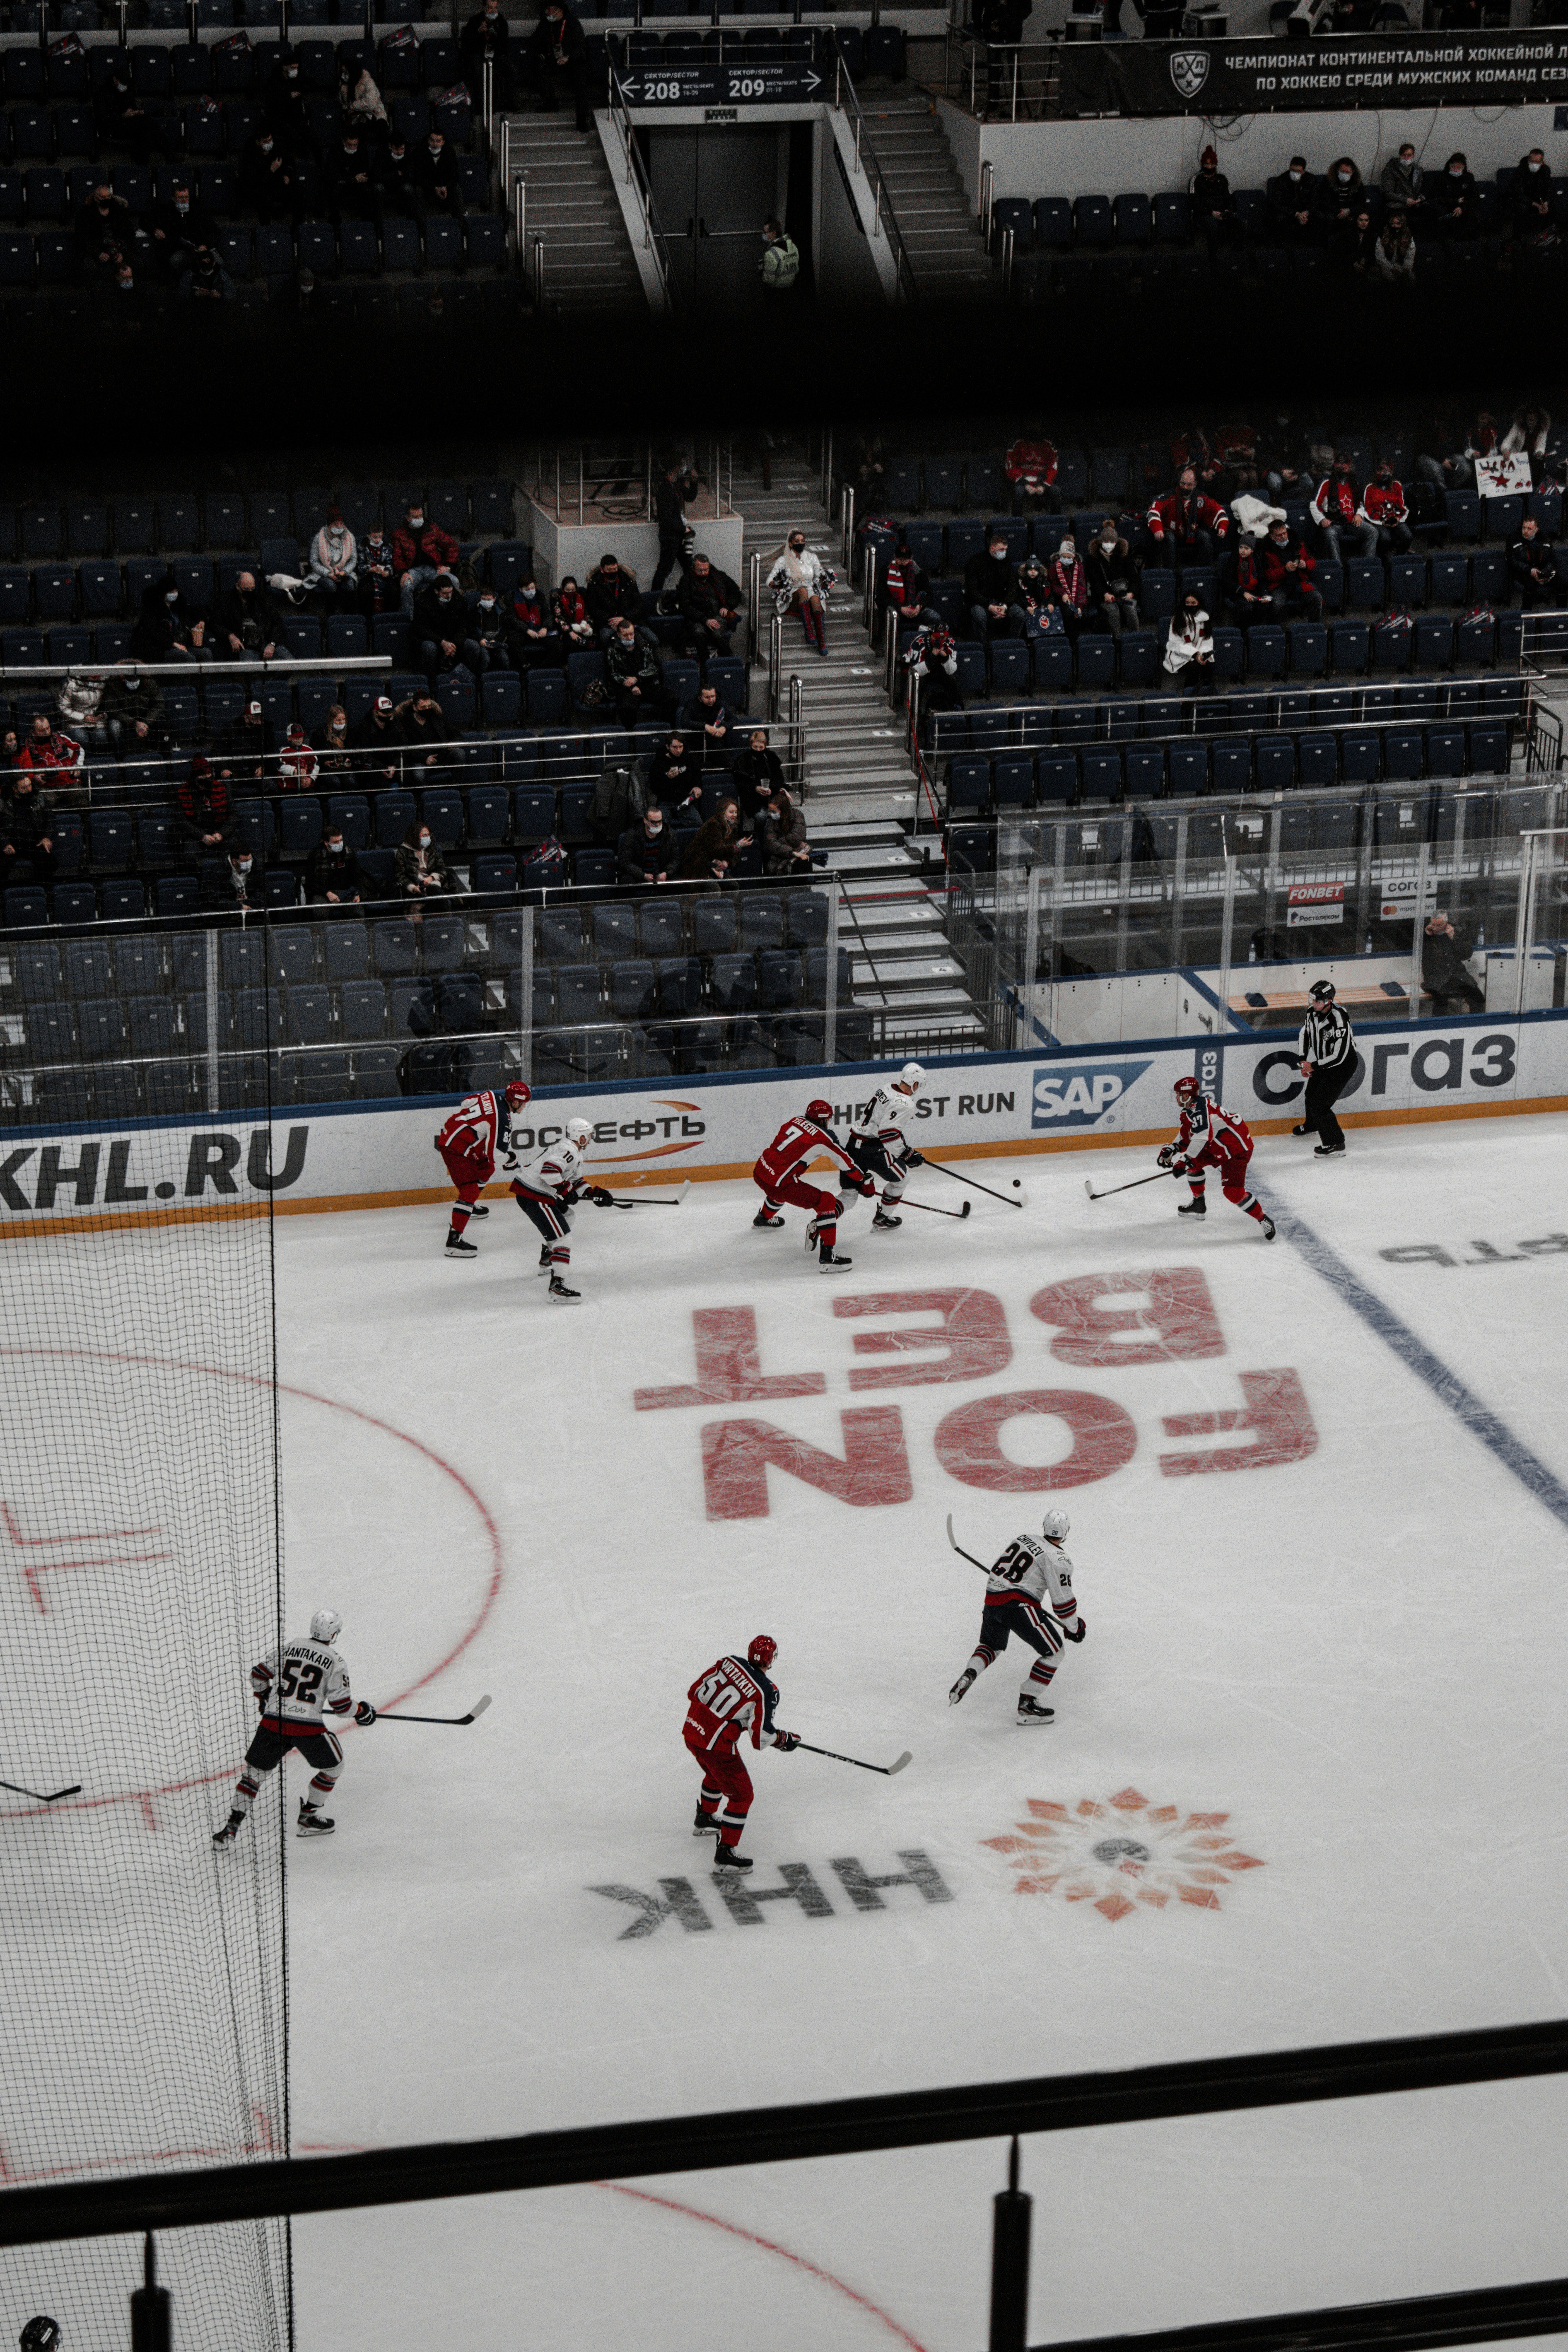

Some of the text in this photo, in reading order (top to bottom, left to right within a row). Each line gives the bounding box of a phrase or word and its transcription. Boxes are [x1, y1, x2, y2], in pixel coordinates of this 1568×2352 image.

[1225, 54, 1315, 69] ЧЕМПИОНАТ
[1320, 46, 1464, 66] КОНТИНЕНТАЛЬНОЙ
[1468, 43, 1554, 61] ХОККЕЙНОЙ
[644, 82, 680, 100] 208
[729, 79, 765, 97] 209
[1256, 67, 1568, 90] ПО ХОККЕЮ СРЕДИ МУЖСКИХ КОМАНД СЕЗ
[1289, 886, 1343, 900] FONBET
[1336, 1028, 1346, 1038] 87
[958, 1092, 1015, 1115] RUN
[1034, 1075, 1123, 1118] SAP
[791, 1118, 818, 1136] TELEGIN
[890, 1111, 897, 1120] 9
[434, 1116, 705, 1152] ОСЕФТЬ
[775, 1124, 804, 1152] 7
[0, 1126, 309, 1210] KHL.RU
[563, 1150, 574, 1164] 10
[634, 1266, 1227, 1411] BET
[700, 1367, 1318, 1521] FON
[991, 1542, 1033, 1583] 28
[277, 1659, 323, 1704] 52
[697, 1669, 741, 1719] 50
